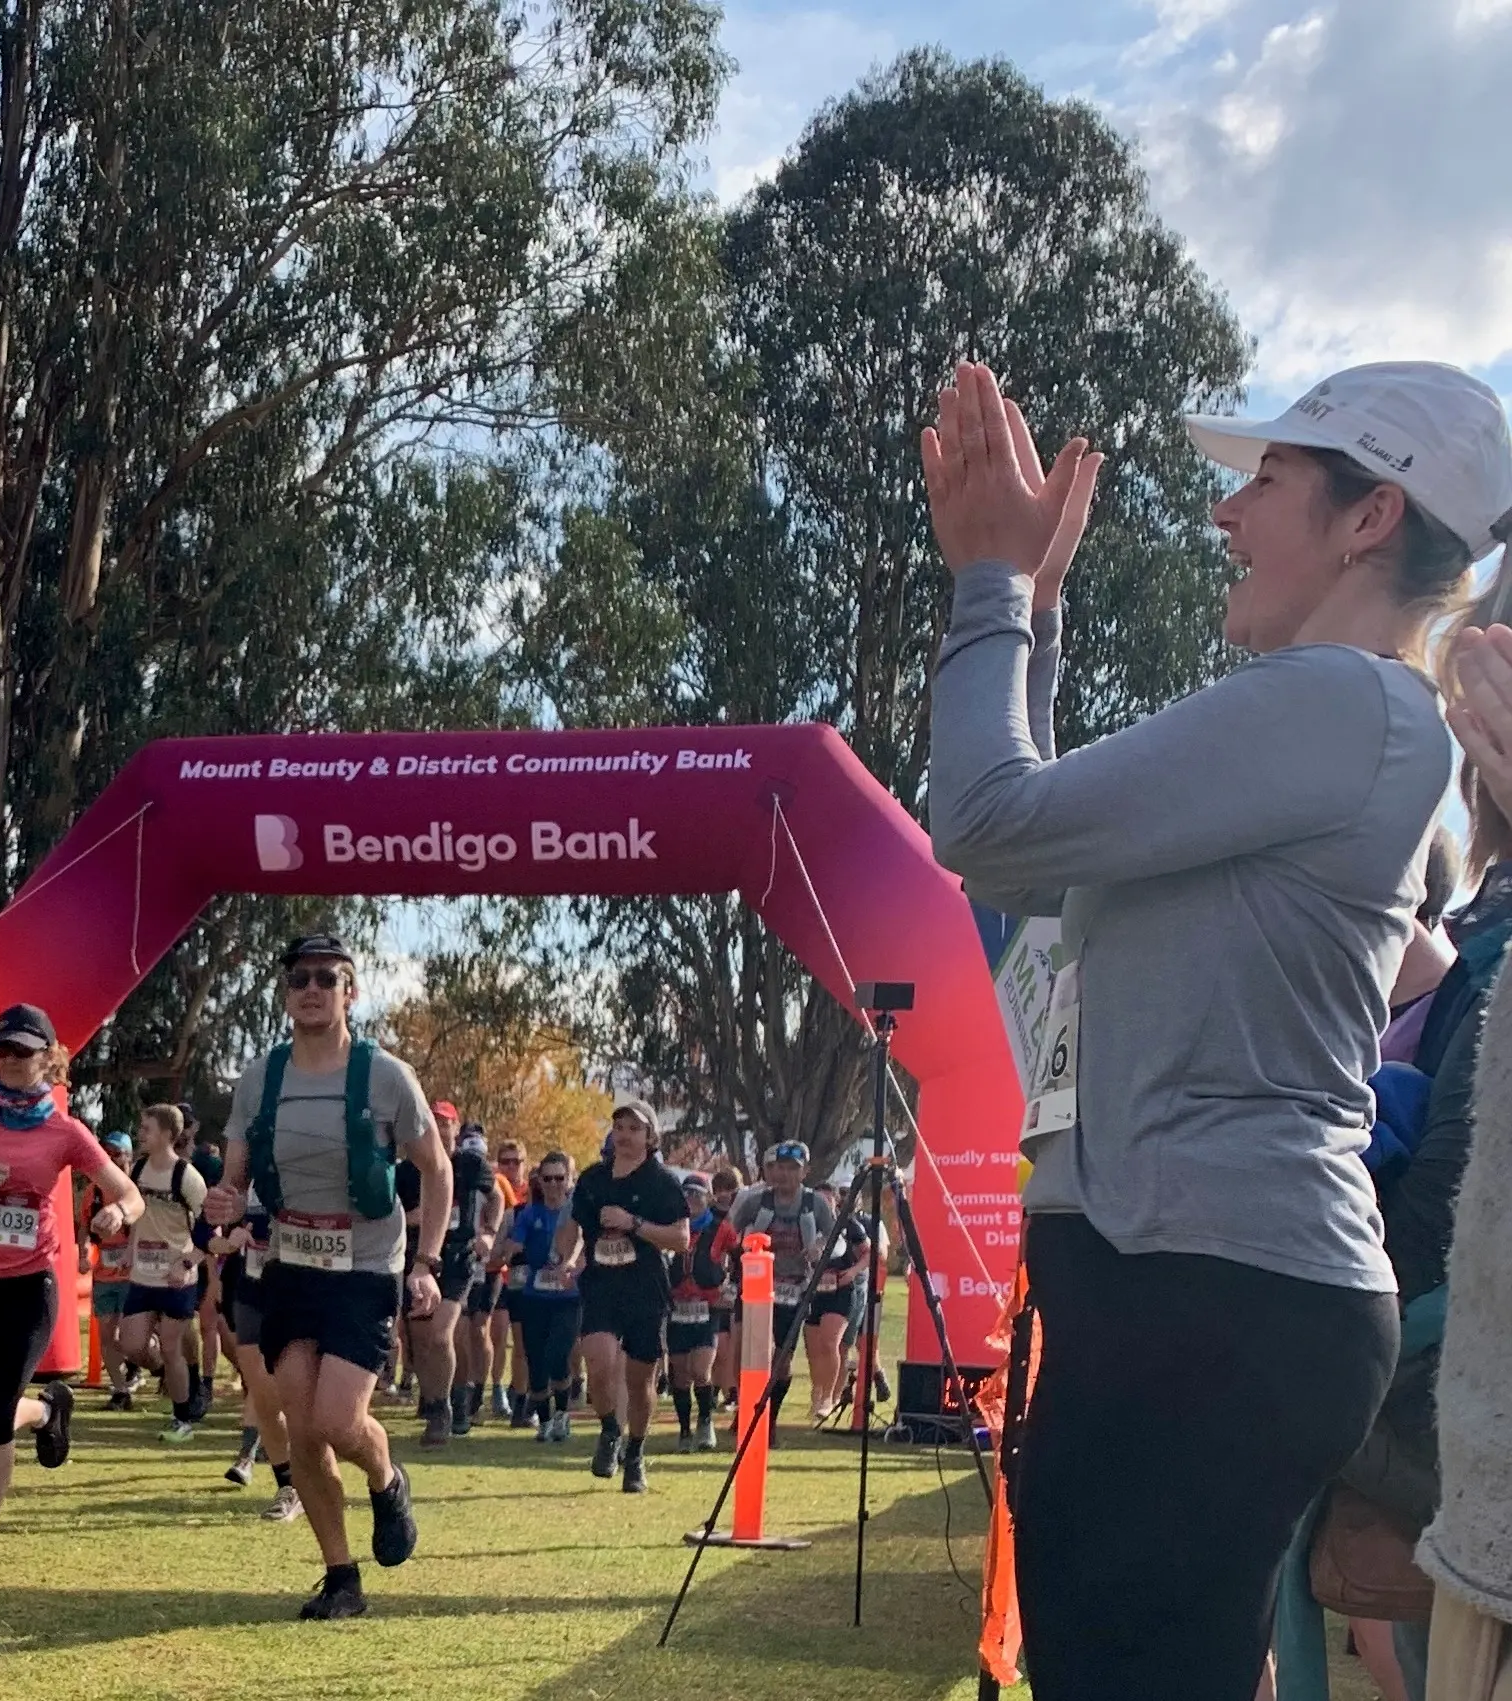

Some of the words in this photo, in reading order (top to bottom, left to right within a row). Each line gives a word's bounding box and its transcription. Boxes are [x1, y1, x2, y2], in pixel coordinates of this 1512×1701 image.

[180, 760, 262, 780] Mount
[268, 758, 364, 782] Beauty
[368, 756, 391, 776] &
[396, 754, 499, 776] District
[506, 751, 669, 775] Community
[676, 748, 753, 770] Bank
[323, 821, 517, 872] Bendigo
[531, 817, 658, 861] Bank
[929, 1151, 985, 1168] Proudly
[948, 1211, 1003, 1226] Mount
[295, 1232, 347, 1255] 18035
